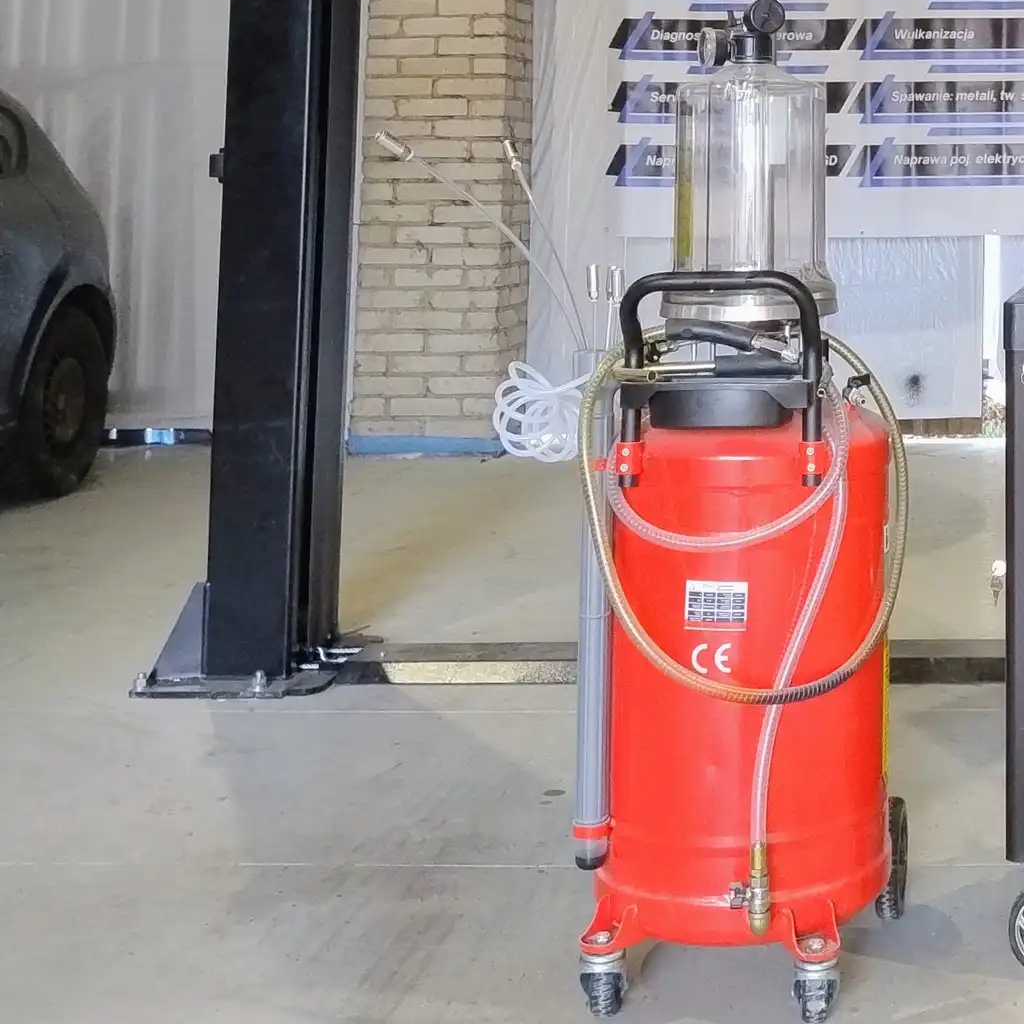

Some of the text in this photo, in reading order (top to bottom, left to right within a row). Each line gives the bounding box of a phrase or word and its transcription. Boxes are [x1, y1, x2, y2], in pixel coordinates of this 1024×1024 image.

[650, 29, 700, 44] Diagnos
[893, 28, 975, 41] Wulkanizacja
[891, 90, 953, 103] Spawanie:
[955, 89, 997, 103] metali,
[893, 154, 947, 166] Naprawa
